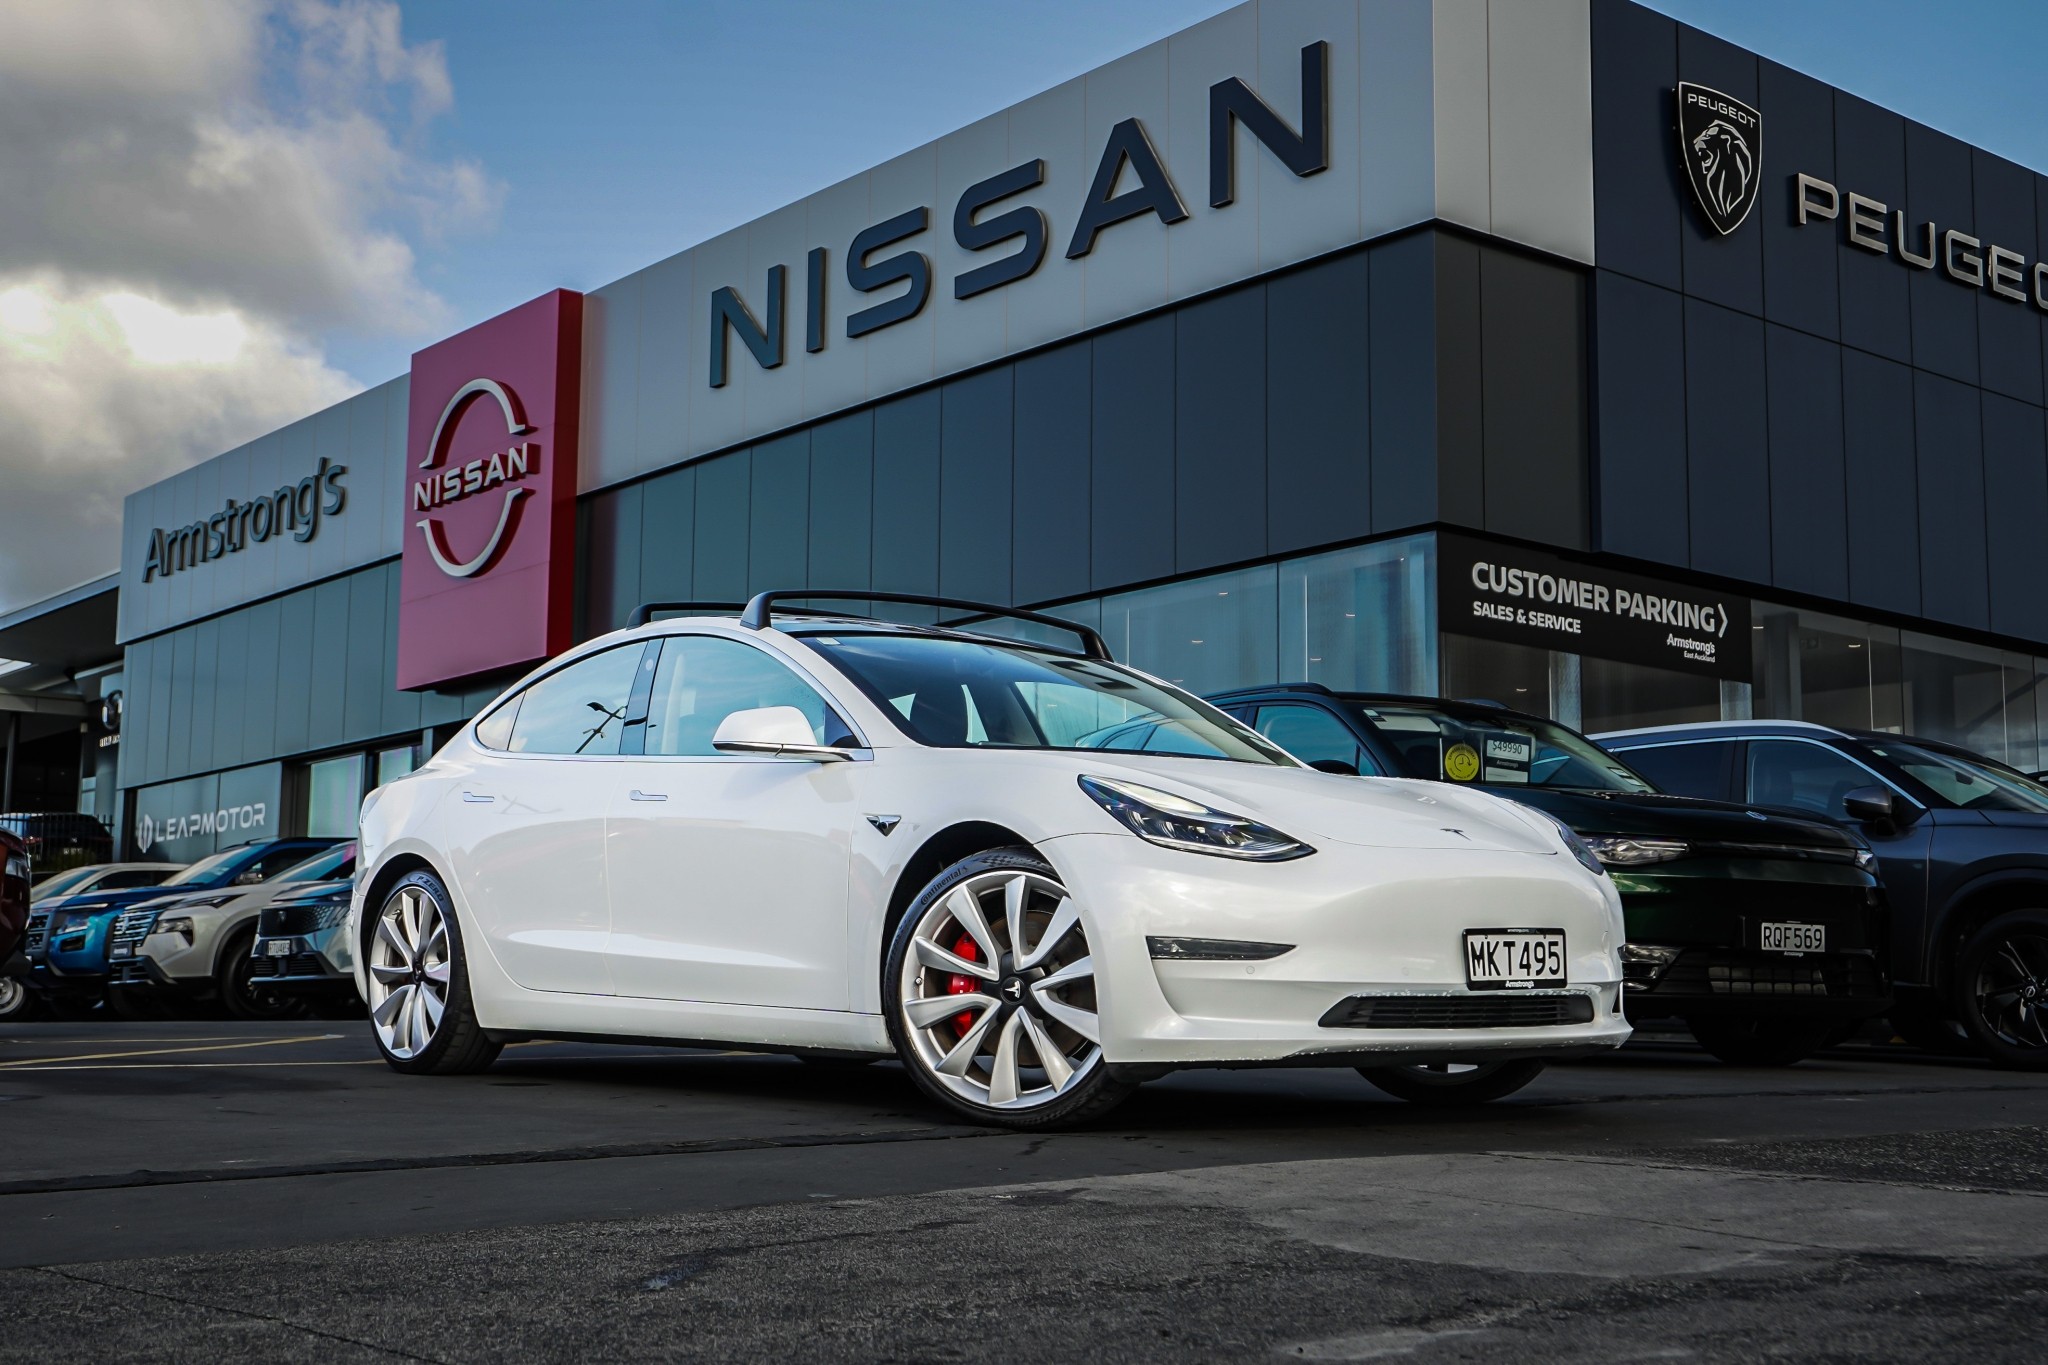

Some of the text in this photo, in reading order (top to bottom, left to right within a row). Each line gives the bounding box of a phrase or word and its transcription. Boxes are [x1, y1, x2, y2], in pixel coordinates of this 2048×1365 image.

[1687, 93, 1757, 129] PEUGEOT
[709, 39, 1329, 389] NISSAN
[413, 442, 531, 511] NISSAN
[142, 456, 348, 583] Armstrong's
[1471, 561, 1716, 633] CUSTOMER PARKING
[1473, 601, 1582, 635] SALES & SERVICE
[1666, 633, 1716, 656] Armstrong's
[1683, 650, 1716, 664] East Auckland
[1492, 740, 1523, 755] $49990
[155, 803, 266, 843] LEAPMOTOR
[423, 878, 445, 902] ZERO
[920, 868, 962, 905] Continental
[1763, 926, 1822, 950] RQF569
[1470, 940, 1561, 977] MKT495
